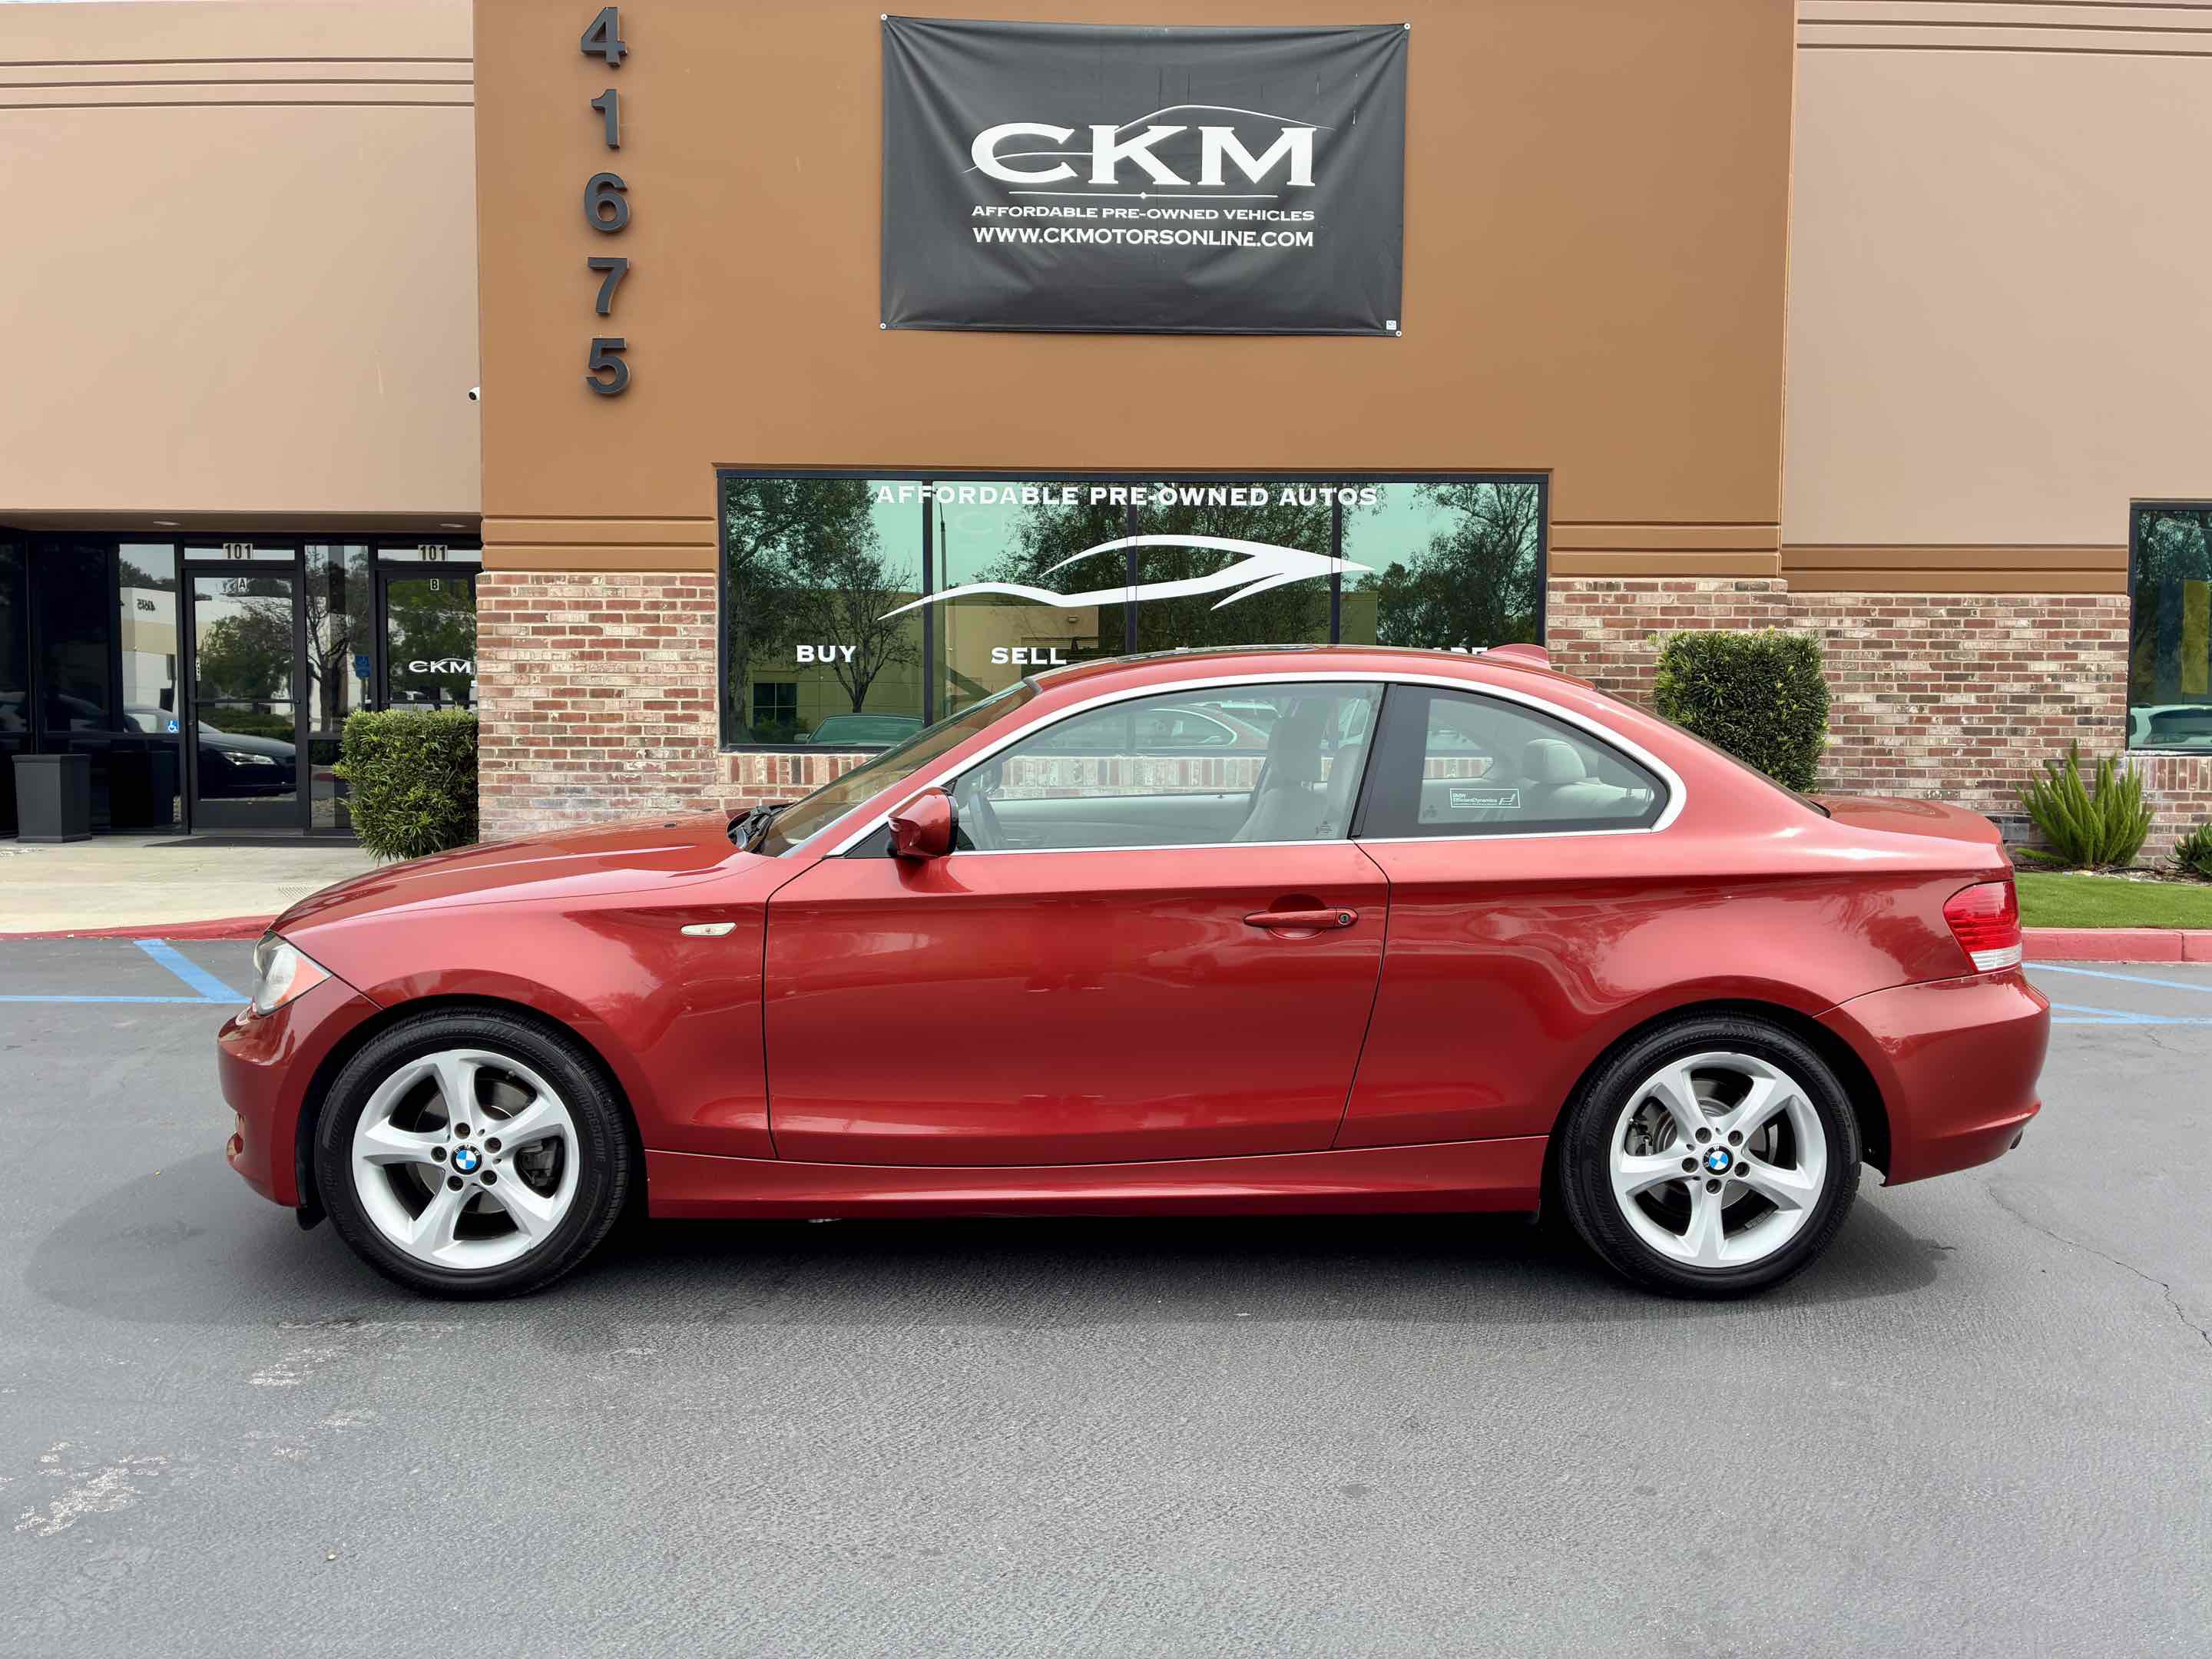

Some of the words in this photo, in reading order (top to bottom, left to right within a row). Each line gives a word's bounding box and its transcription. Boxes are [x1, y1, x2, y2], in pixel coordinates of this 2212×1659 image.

[971, 122, 1316, 187] CKM
[581, 6, 630, 396] 41675
[972, 205, 1098, 219] AFFORDABLE
[1102, 207, 1218, 220] PRE-OWNED
[1223, 208, 1315, 222] VEHICLES
[973, 227, 1314, 248] WWW.CKMOTORSONLINE.COM
[876, 485, 1079, 505] AFFORDABLE
[1090, 486, 1269, 506] PRE-OWNED
[1279, 487, 1377, 506] AUTOS
[224, 544, 252, 559] 101
[420, 545, 447, 561] 101
[238, 578, 247, 589] A
[431, 579, 439, 589] B
[796, 644, 856, 663] BUY
[991, 647, 1067, 664] SELL
[408, 660, 472, 674] CKM
